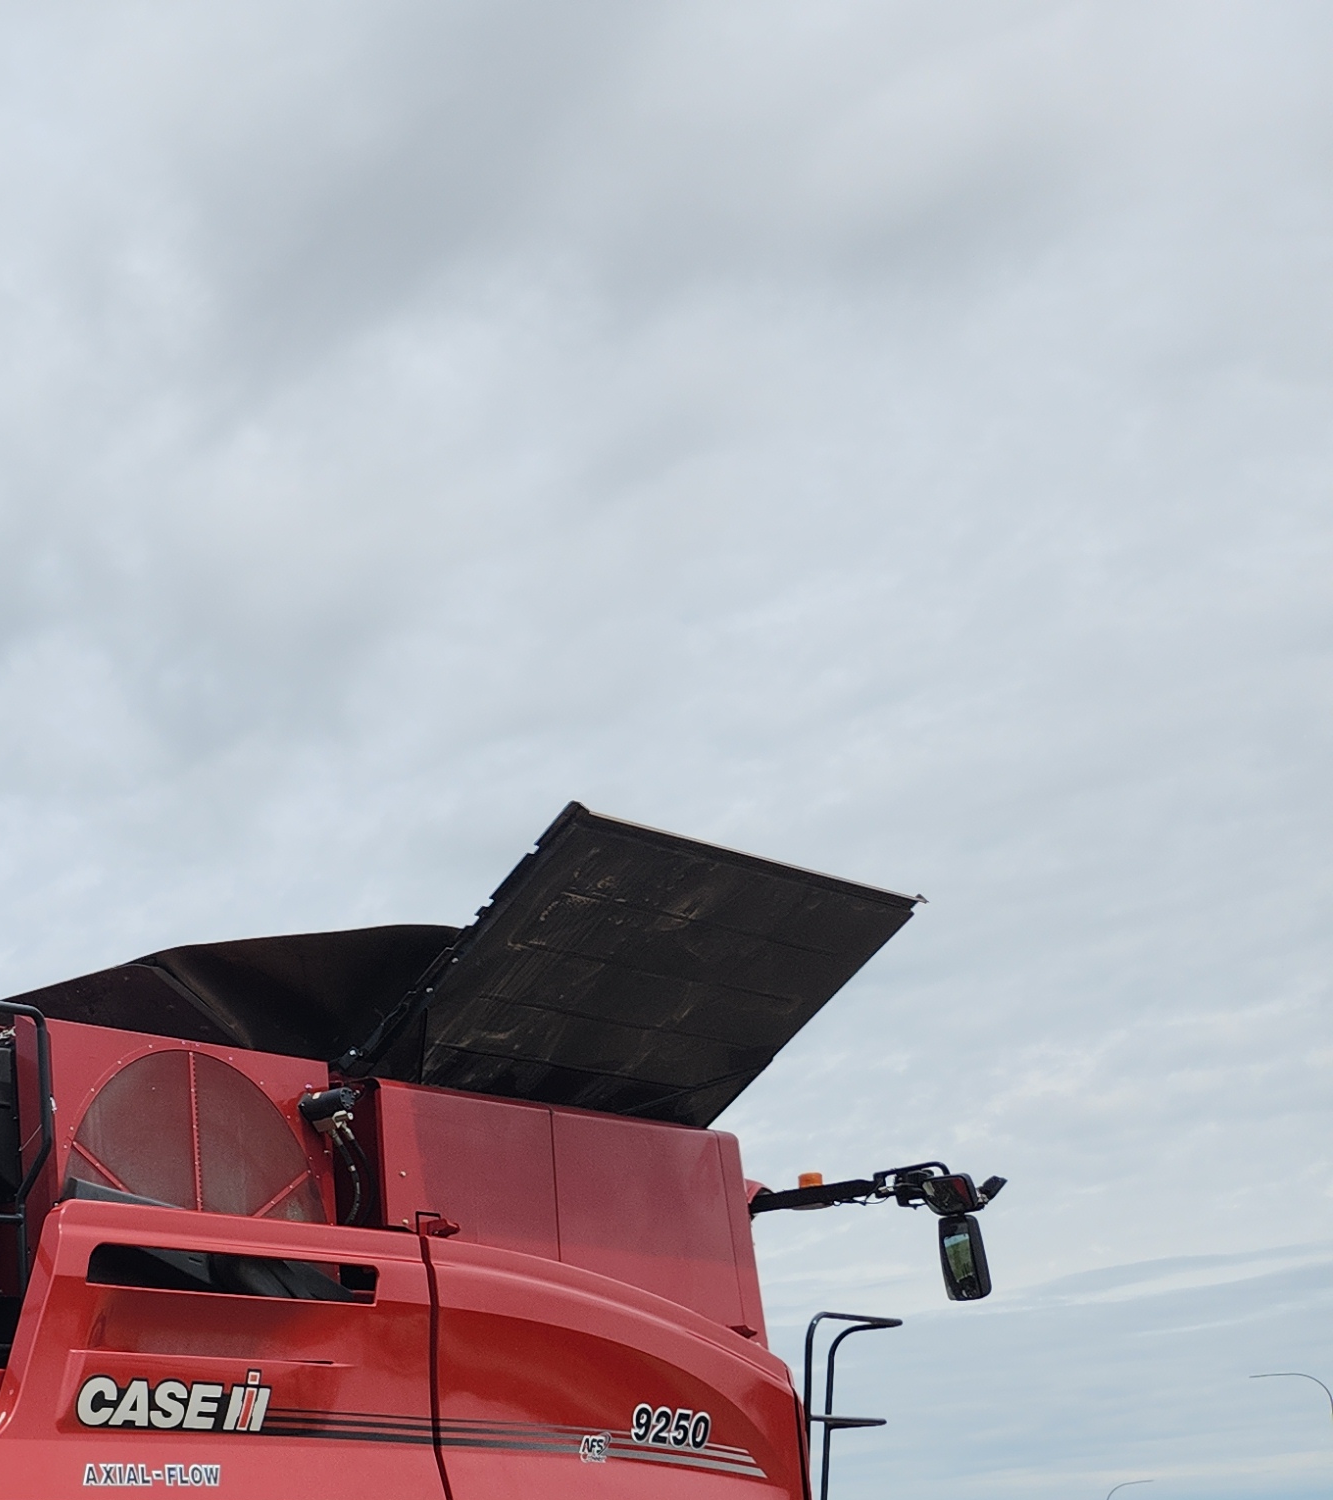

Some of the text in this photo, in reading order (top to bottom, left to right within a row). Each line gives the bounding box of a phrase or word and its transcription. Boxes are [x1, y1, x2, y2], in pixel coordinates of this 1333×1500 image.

[77, 1371, 271, 1431] CASE IH
[631, 1403, 711, 1449] 9250
[580, 1435, 605, 1454] AFS
[83, 1464, 220, 1486] AXIAL-FLOW
